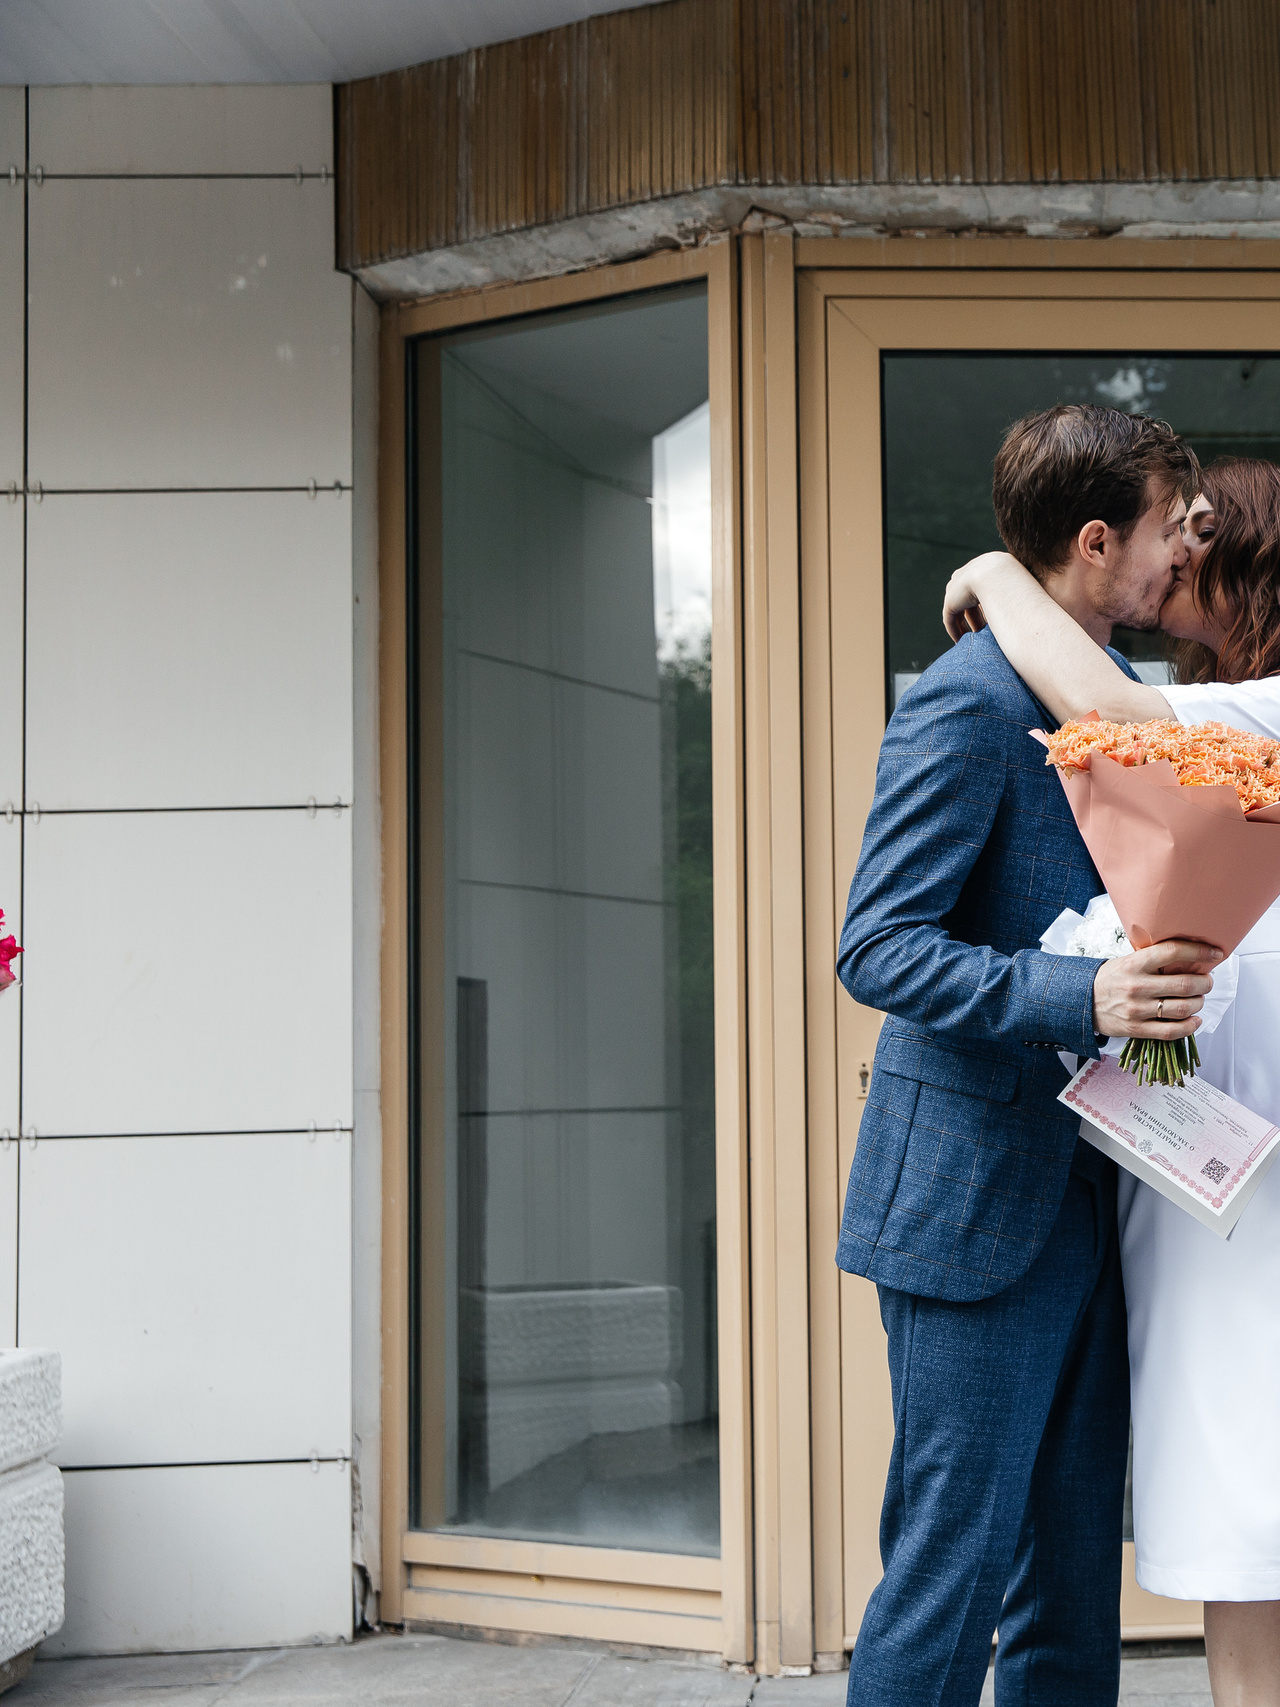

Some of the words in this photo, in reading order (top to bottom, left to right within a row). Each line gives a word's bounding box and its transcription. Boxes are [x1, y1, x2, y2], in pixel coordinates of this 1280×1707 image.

[1127, 1100, 1148, 1117] БРАКА
[1132, 1112, 1181, 1151] СВИДЕТЕЛЬСТВО
[1147, 1114, 1189, 1147] ЗАКЛЮЧЕНИИ
